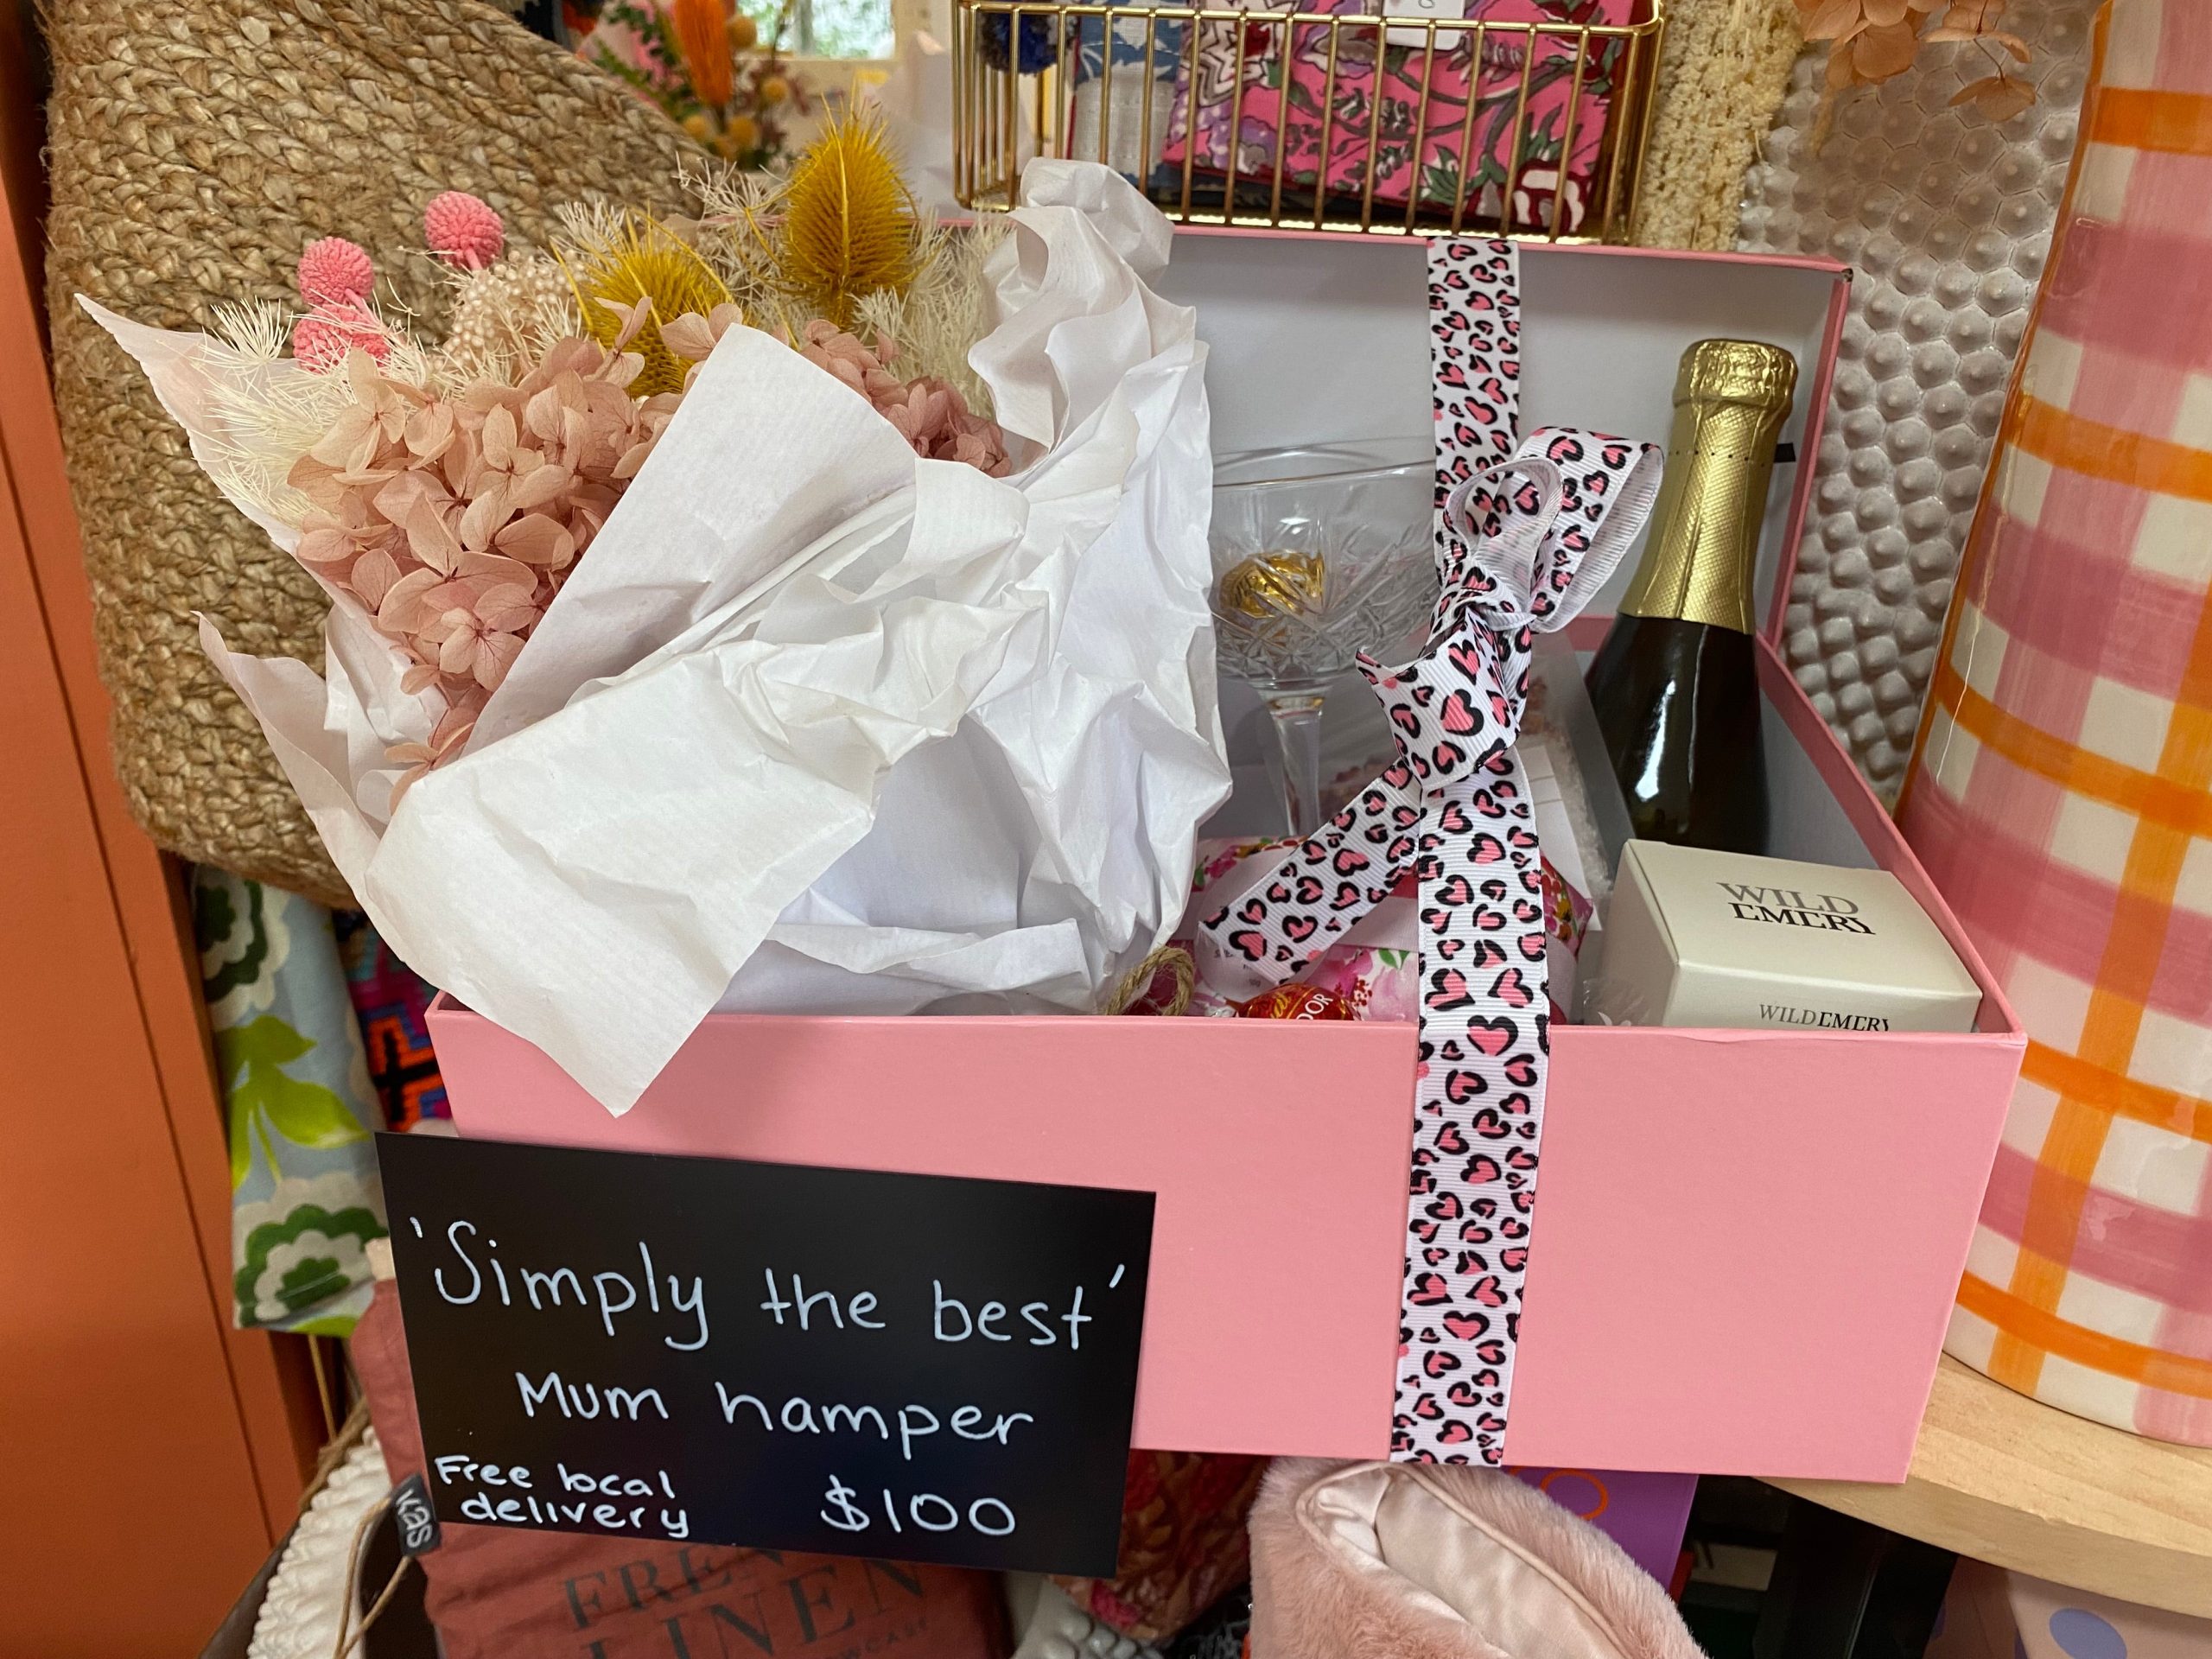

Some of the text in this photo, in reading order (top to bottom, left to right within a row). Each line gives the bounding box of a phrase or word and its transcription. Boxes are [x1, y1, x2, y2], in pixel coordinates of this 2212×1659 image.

[1716, 882, 1859, 915] WILD
[1727, 902, 1877, 935] EMERY
[760, 1267, 887, 1332] the
[515, 1371, 1035, 1460] Mum hamper
[435, 1454, 677, 1500] Free local
[461, 1489, 690, 1538] delivery
[820, 1473, 1017, 1536] $100
